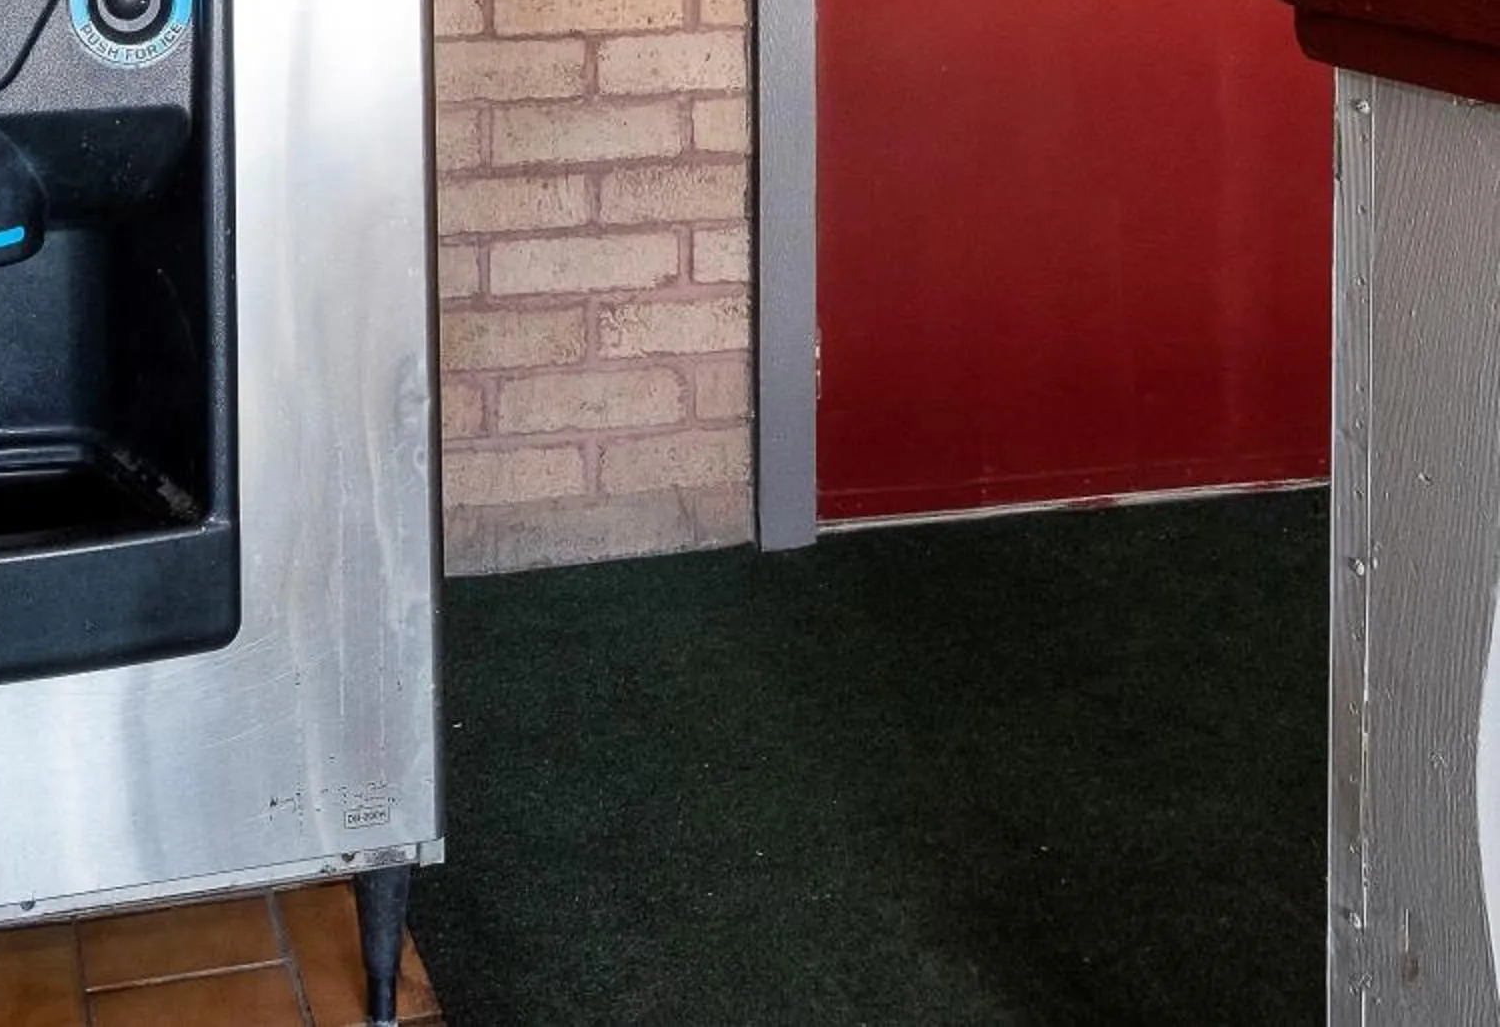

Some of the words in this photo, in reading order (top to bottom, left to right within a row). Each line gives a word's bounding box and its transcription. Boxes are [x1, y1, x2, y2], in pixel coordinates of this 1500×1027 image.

[80, 26, 118, 58] PUSH
[126, 46, 157, 60] FOR
[161, 23, 184, 48] ICE
